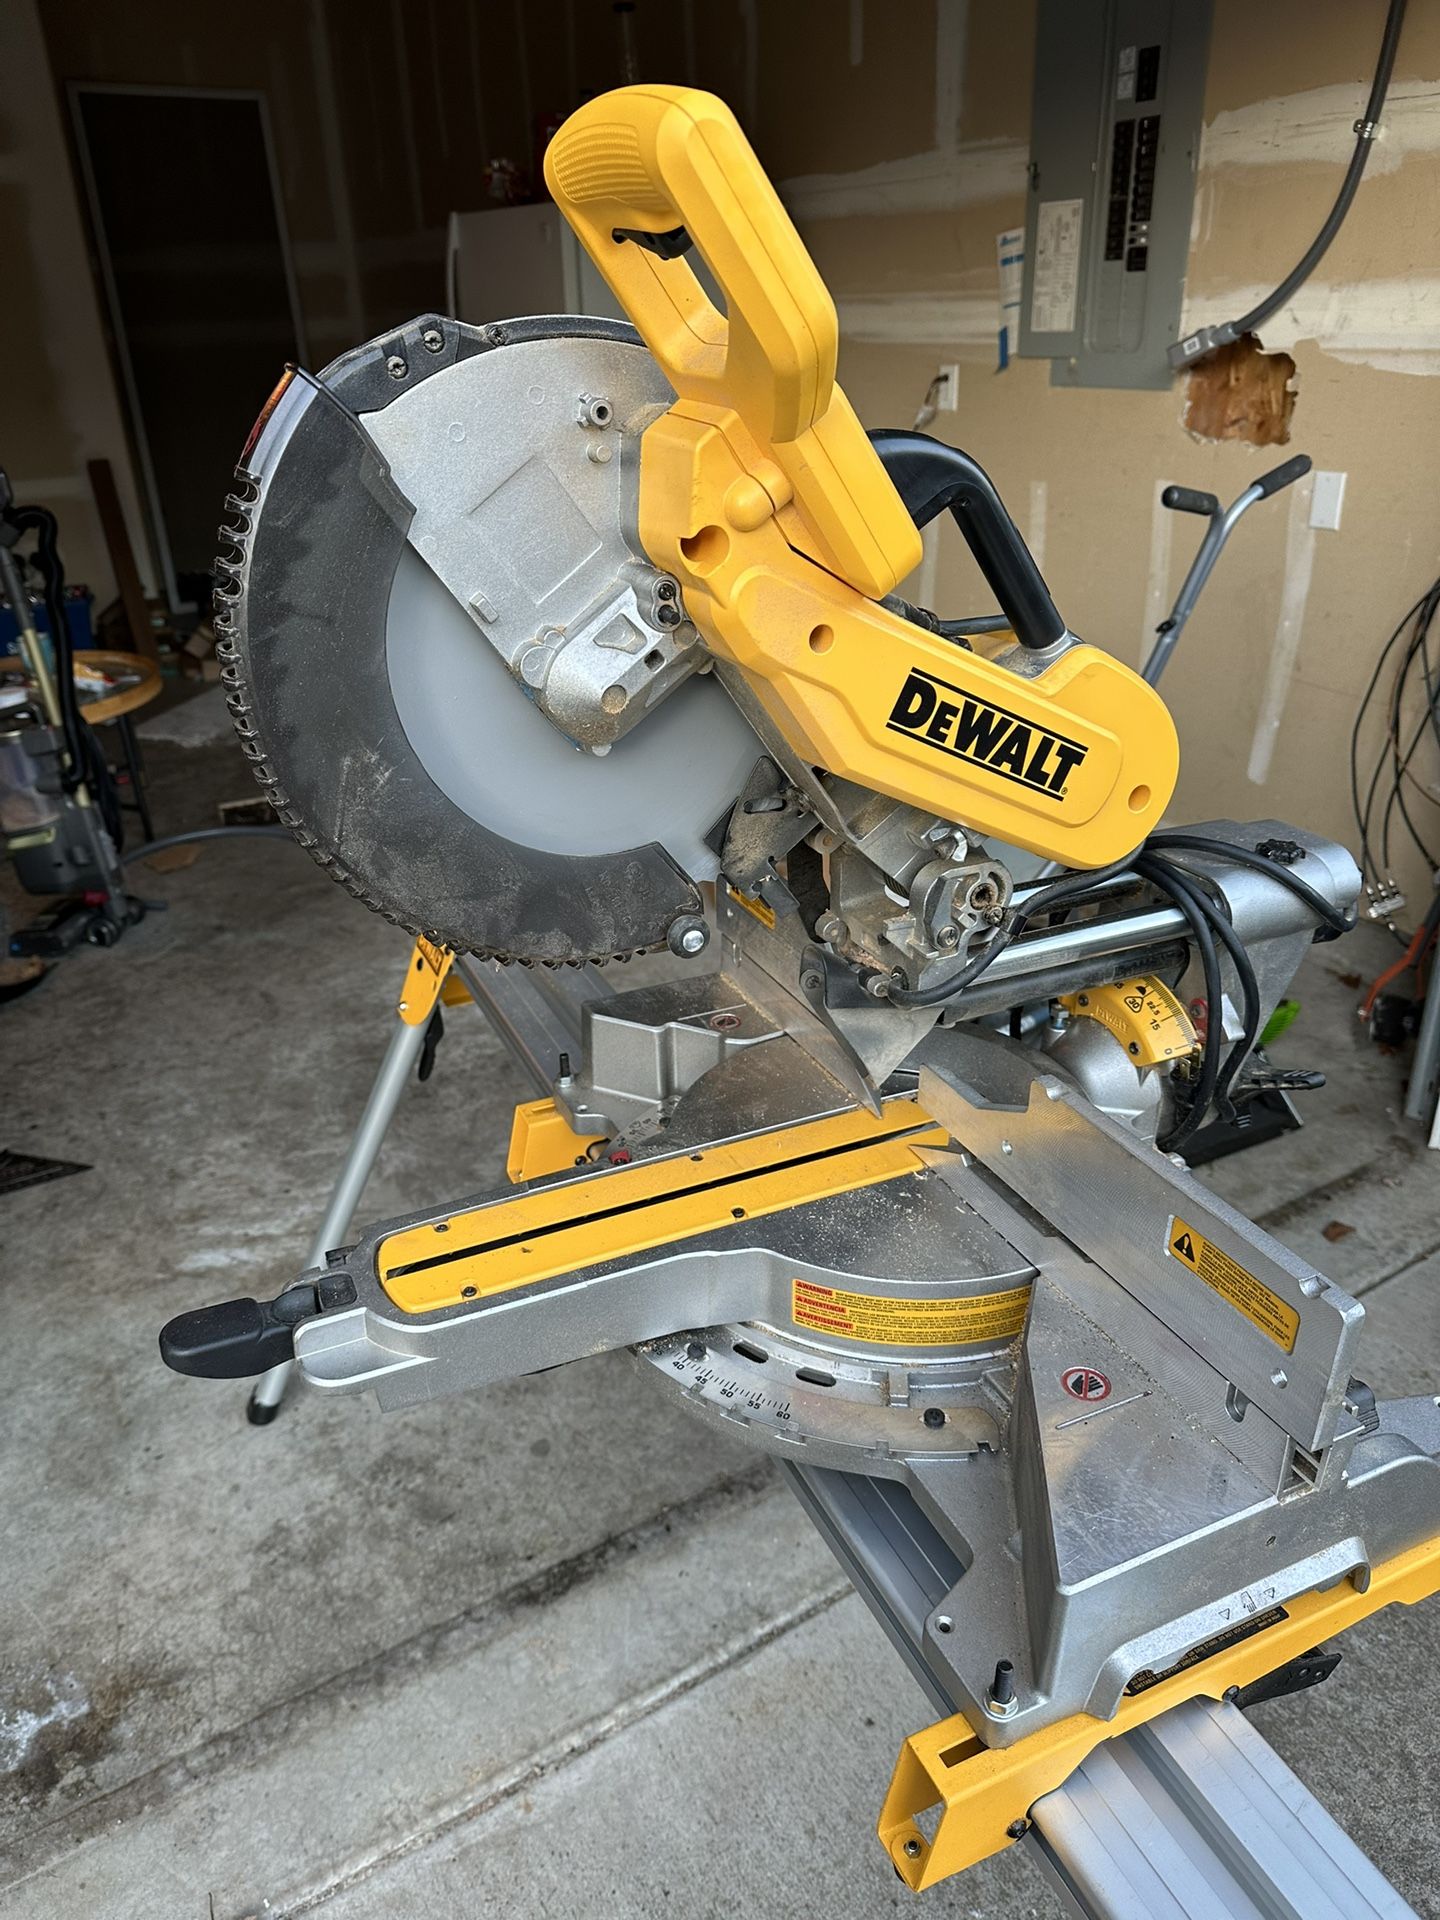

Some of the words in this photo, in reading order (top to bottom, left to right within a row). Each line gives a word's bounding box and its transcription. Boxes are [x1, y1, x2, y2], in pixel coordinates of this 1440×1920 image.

[1128, 998, 1140, 1009] 30
[1146, 1001, 1160, 1016] 22.5
[1150, 1018, 1161, 1031] 15
[800, 1281, 833, 1297] WARNING
[803, 1297, 846, 1314] ADVERTENCIA
[802, 1311, 853, 1329] AVERTISSEMENT
[672, 1360, 685, 1371] 40
[695, 1375, 709, 1385] 45
[720, 1388, 734, 1398] 50
[747, 1400, 761, 1410] 55
[776, 1410, 791, 1420] 60
